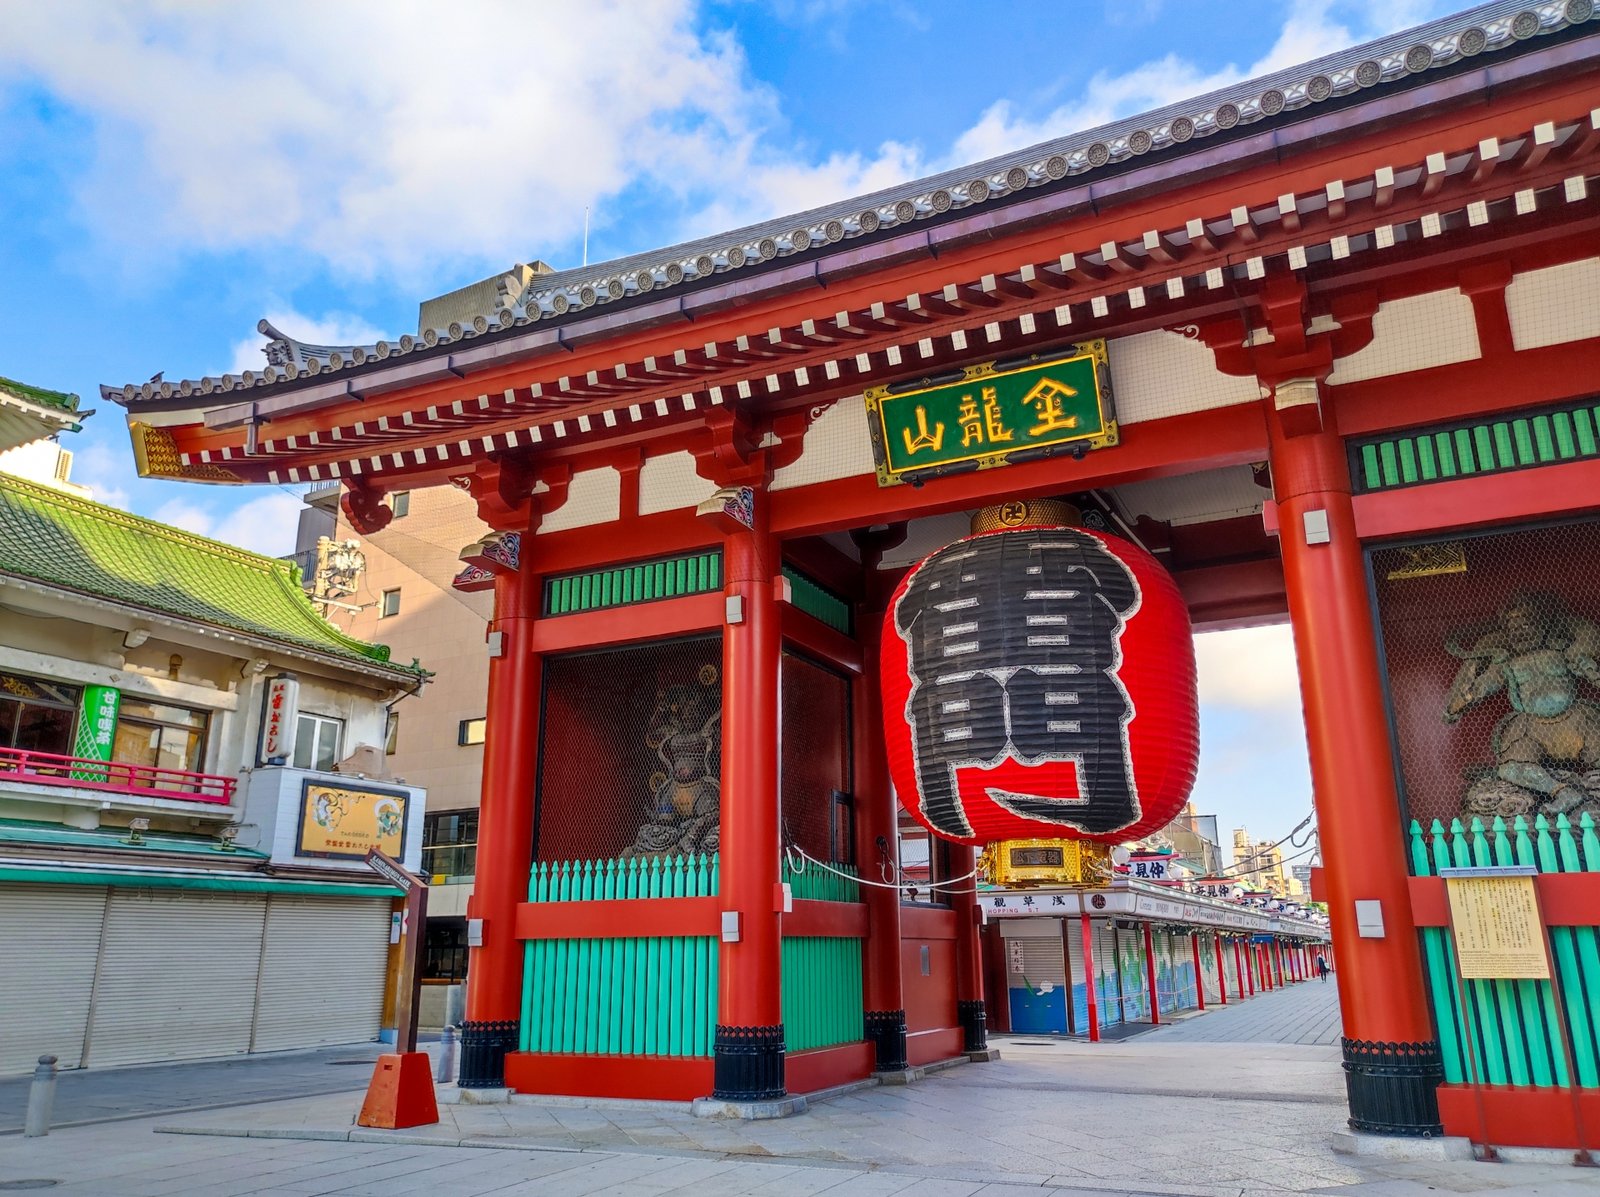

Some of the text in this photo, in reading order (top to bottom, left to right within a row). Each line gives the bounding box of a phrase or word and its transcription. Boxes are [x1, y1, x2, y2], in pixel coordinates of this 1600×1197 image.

[894, 527, 1142, 838] 雷門
[95, 691, 117, 745] 甘味喫茶
[986, 907, 1019, 915] HOPPING
